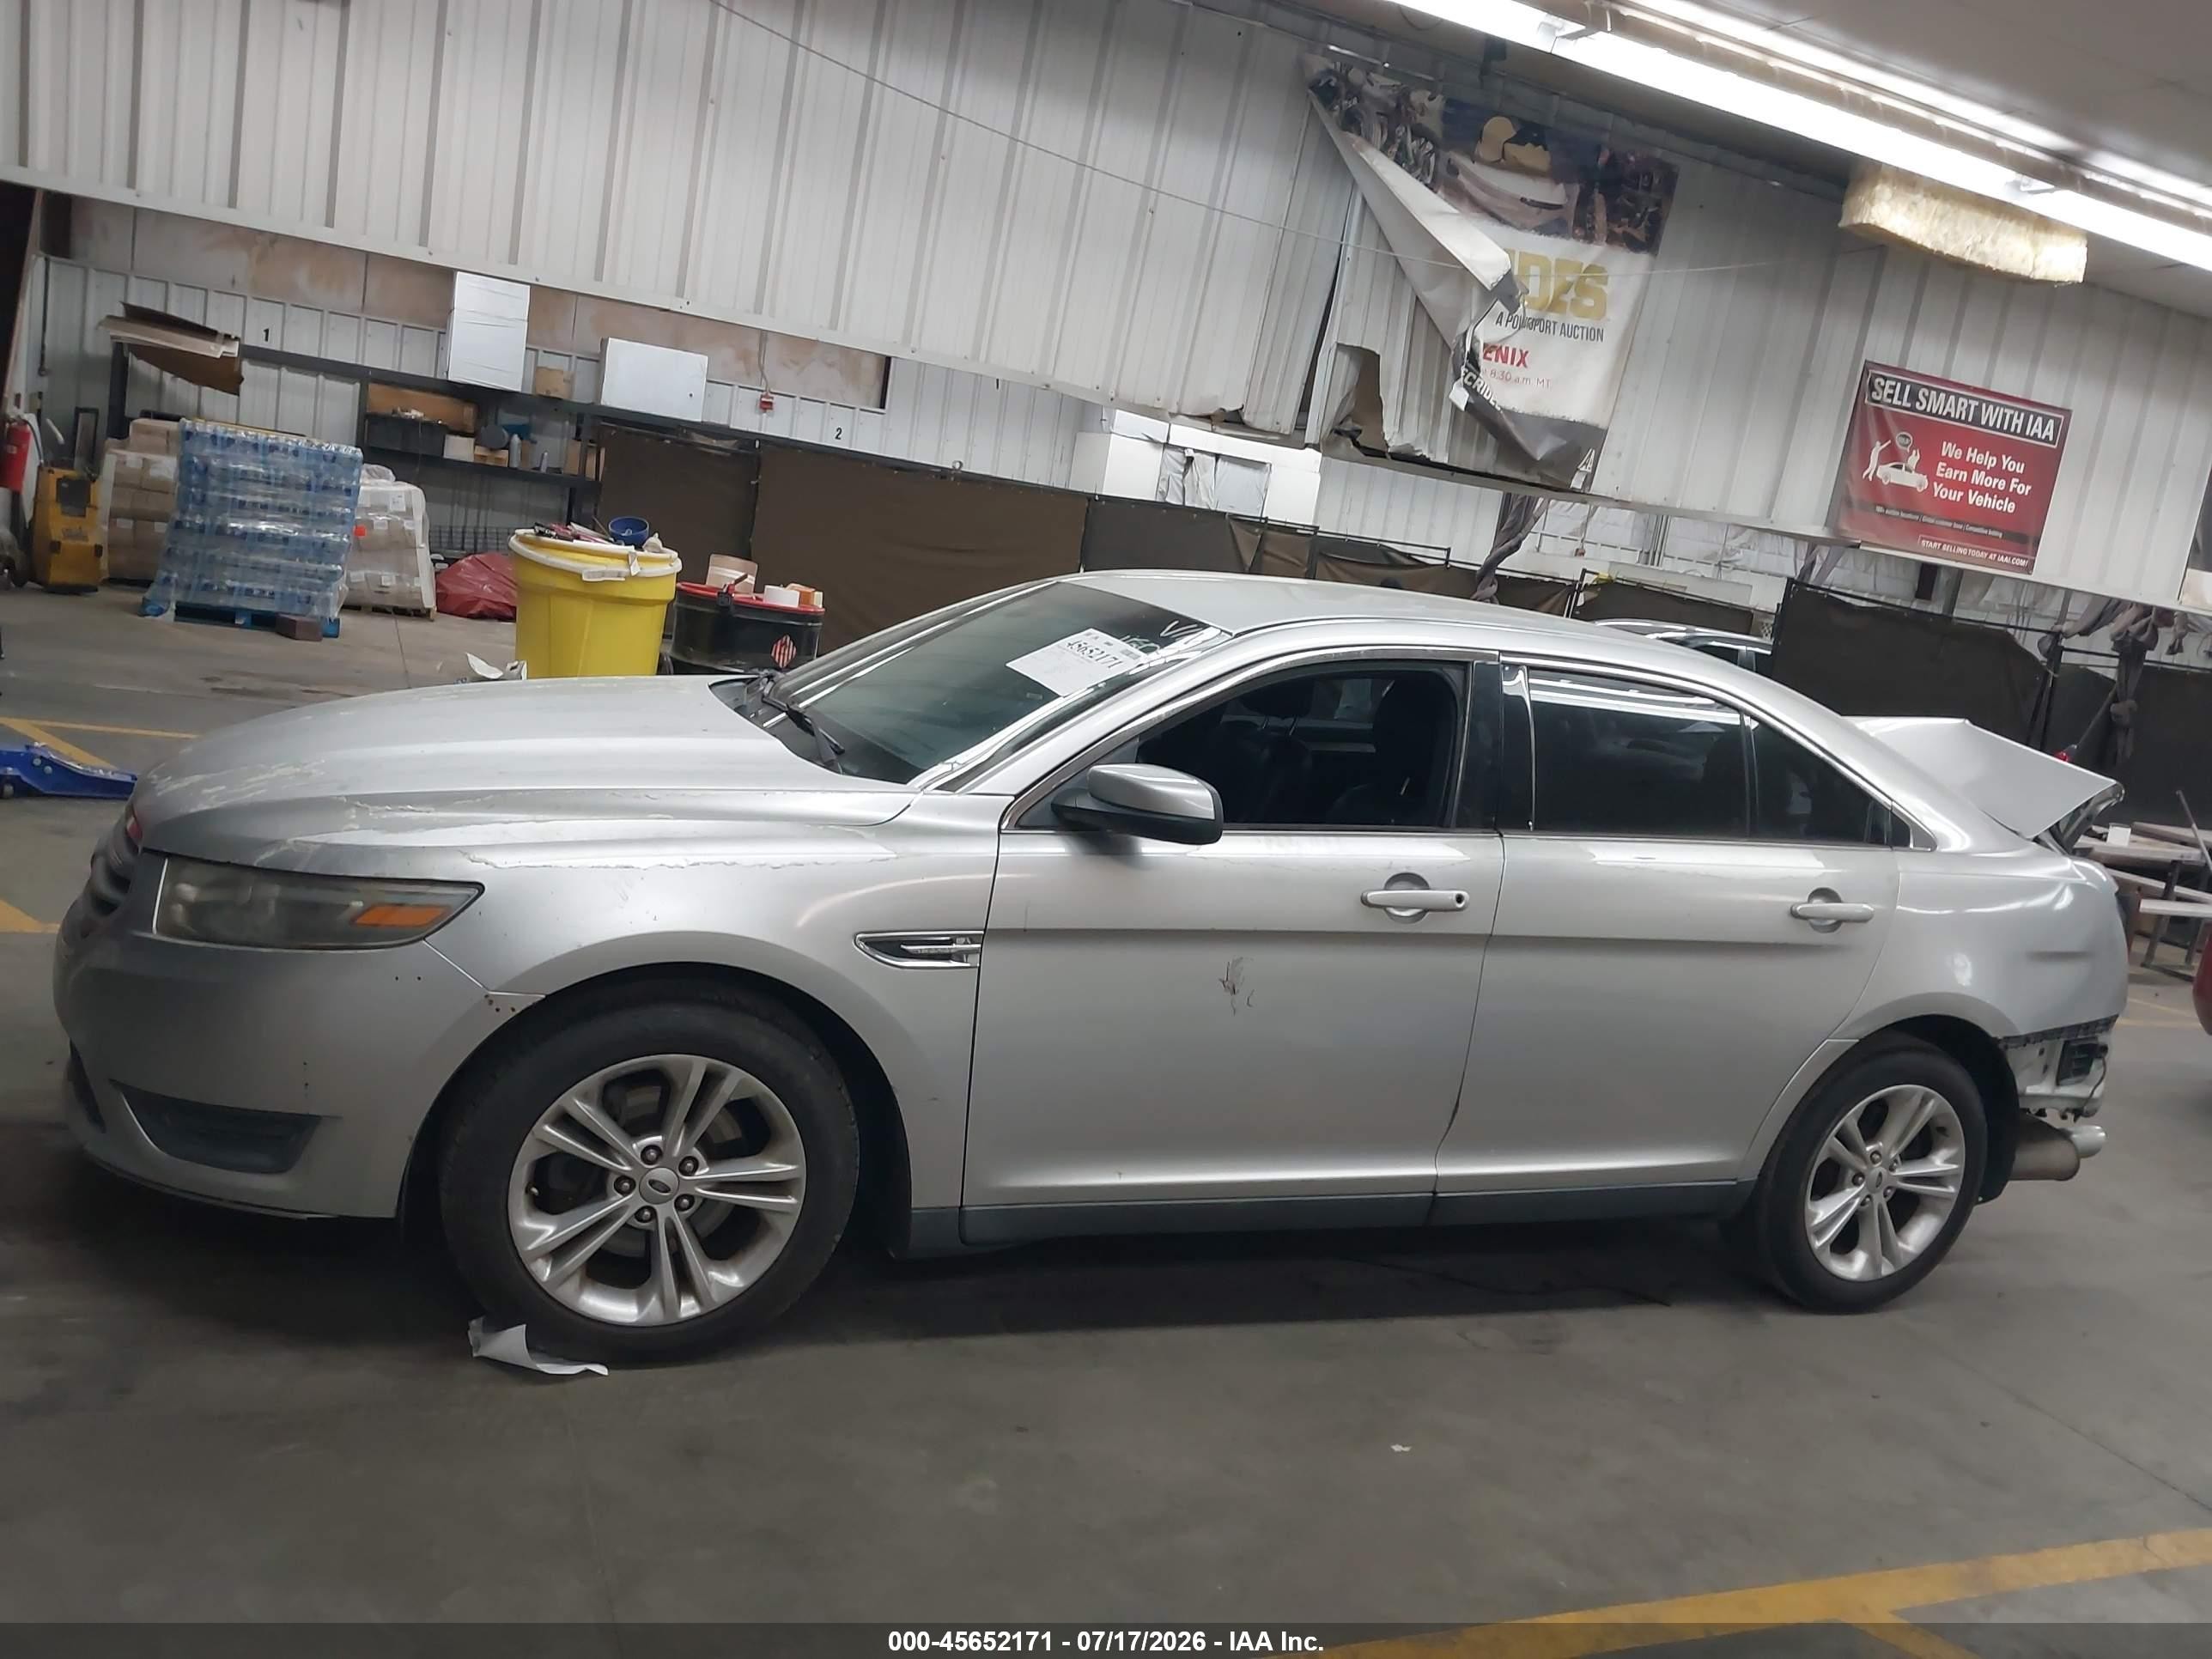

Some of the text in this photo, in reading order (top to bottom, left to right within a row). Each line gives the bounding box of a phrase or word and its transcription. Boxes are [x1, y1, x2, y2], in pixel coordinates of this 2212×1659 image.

[263, 328, 270, 343] 1
[1495, 311, 1504, 327] A
[1559, 322, 1604, 343] AUCTION
[1483, 343, 1528, 368] ENIX
[1871, 377, 2055, 441] SELL SMART WITH IAA
[835, 427, 842, 441] 2
[1941, 441, 2026, 474] We Help You
[1936, 462, 2033, 495] Earn More For
[1932, 482, 2016, 514] Your Vehicle
[1921, 539, 1942, 550] START
[1942, 544, 1967, 555] SELLING
[1967, 548, 1989, 559] TODAY
